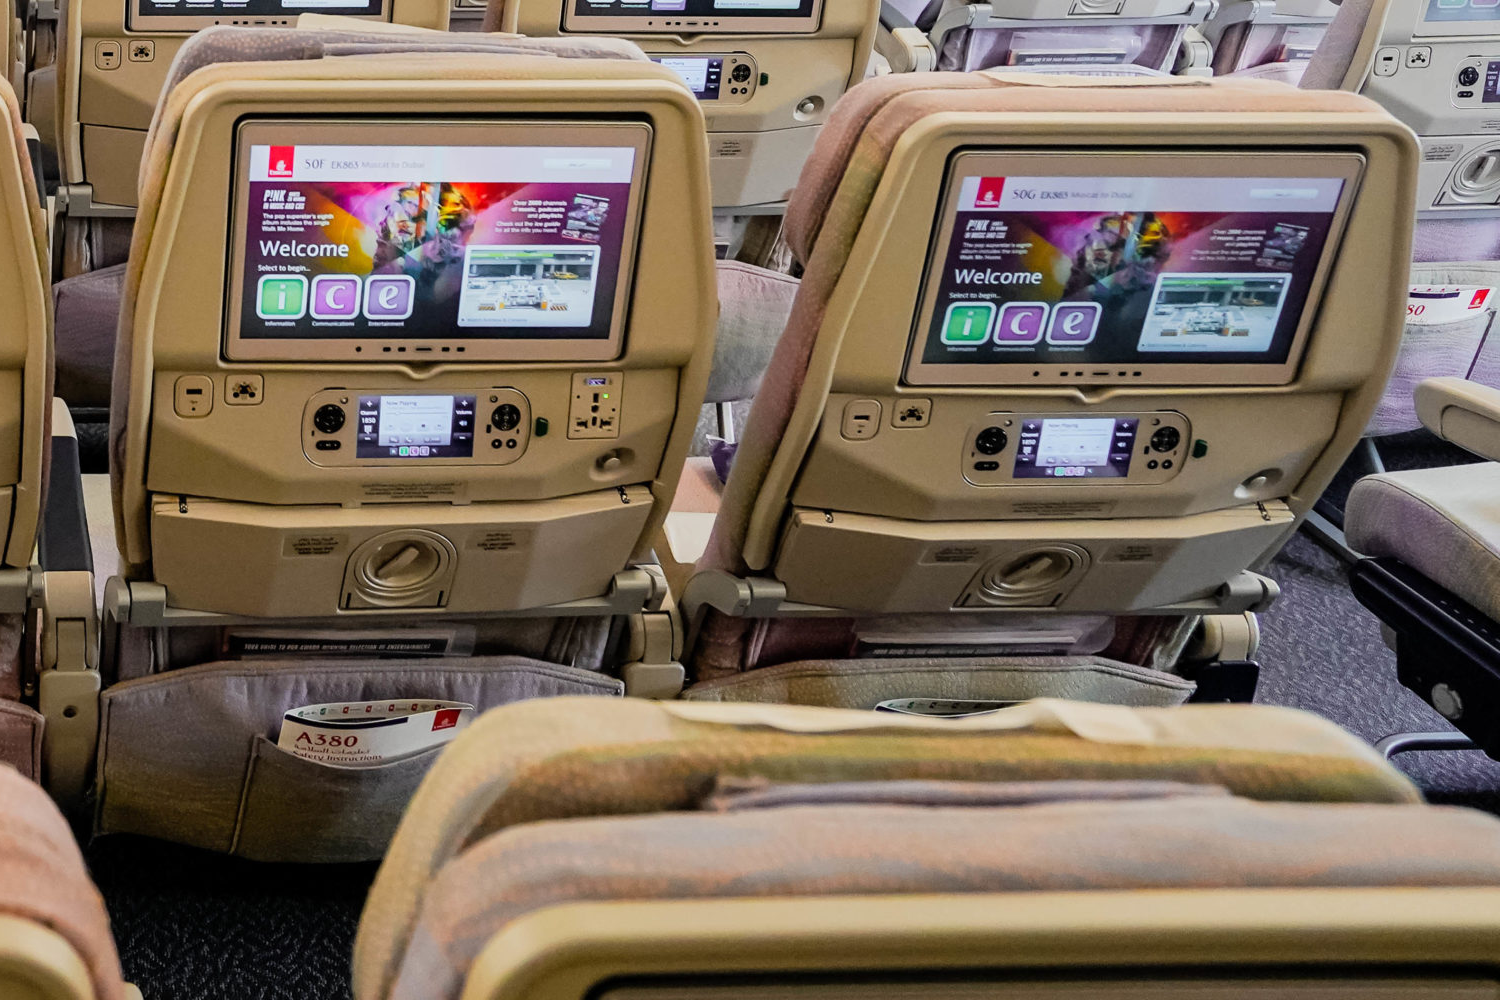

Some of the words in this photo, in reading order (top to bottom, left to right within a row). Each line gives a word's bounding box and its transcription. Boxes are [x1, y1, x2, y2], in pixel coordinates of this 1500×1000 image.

[263, 190, 287, 202] P!NK
[1012, 189, 1036, 200] 50G
[259, 240, 349, 257] Welcome
[954, 268, 1043, 285] Welcome
[278, 284, 286, 310] i
[378, 285, 399, 310] e
[962, 311, 974, 336] i
[1063, 311, 1085, 335] e
[296, 732, 358, 748] A380
[327, 754, 382, 762] Instructions
